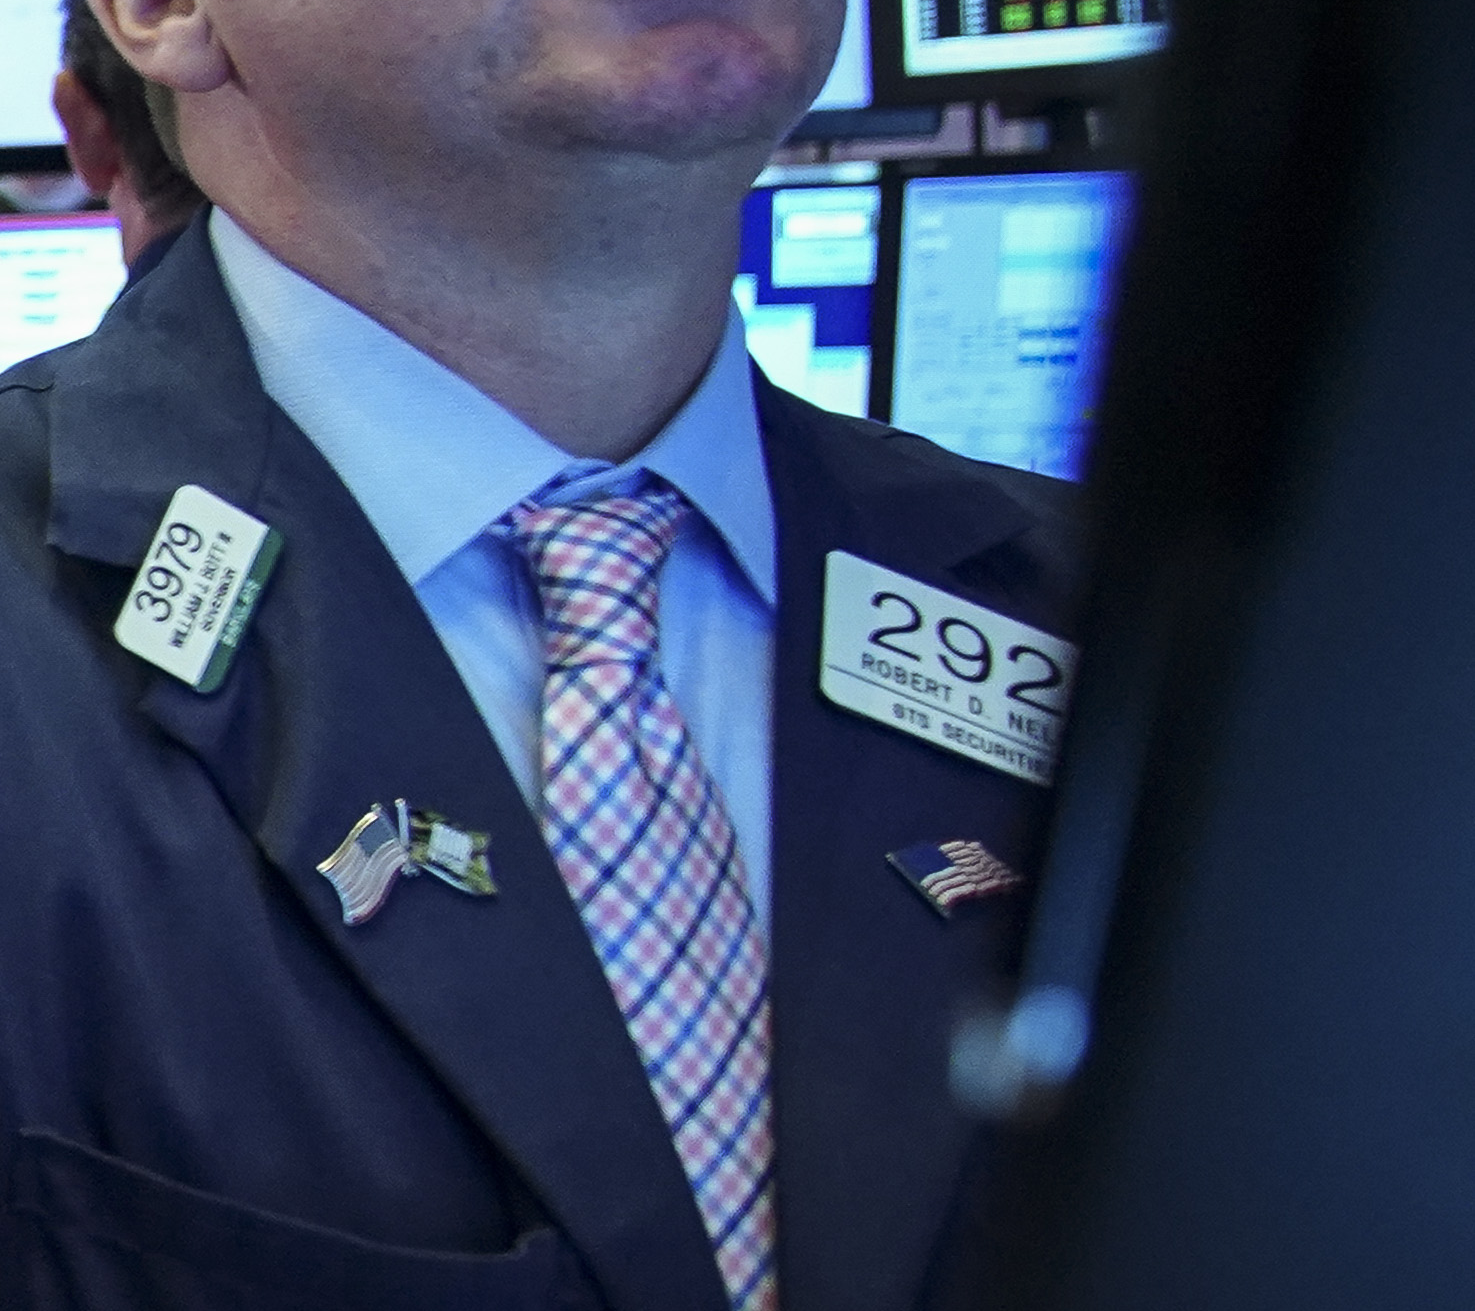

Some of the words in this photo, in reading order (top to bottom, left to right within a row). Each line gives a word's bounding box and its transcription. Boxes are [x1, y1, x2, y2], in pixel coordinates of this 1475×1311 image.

[135, 521, 204, 623] 3979
[860, 652, 953, 703] ROBERT
[867, 591, 1064, 718] 292
